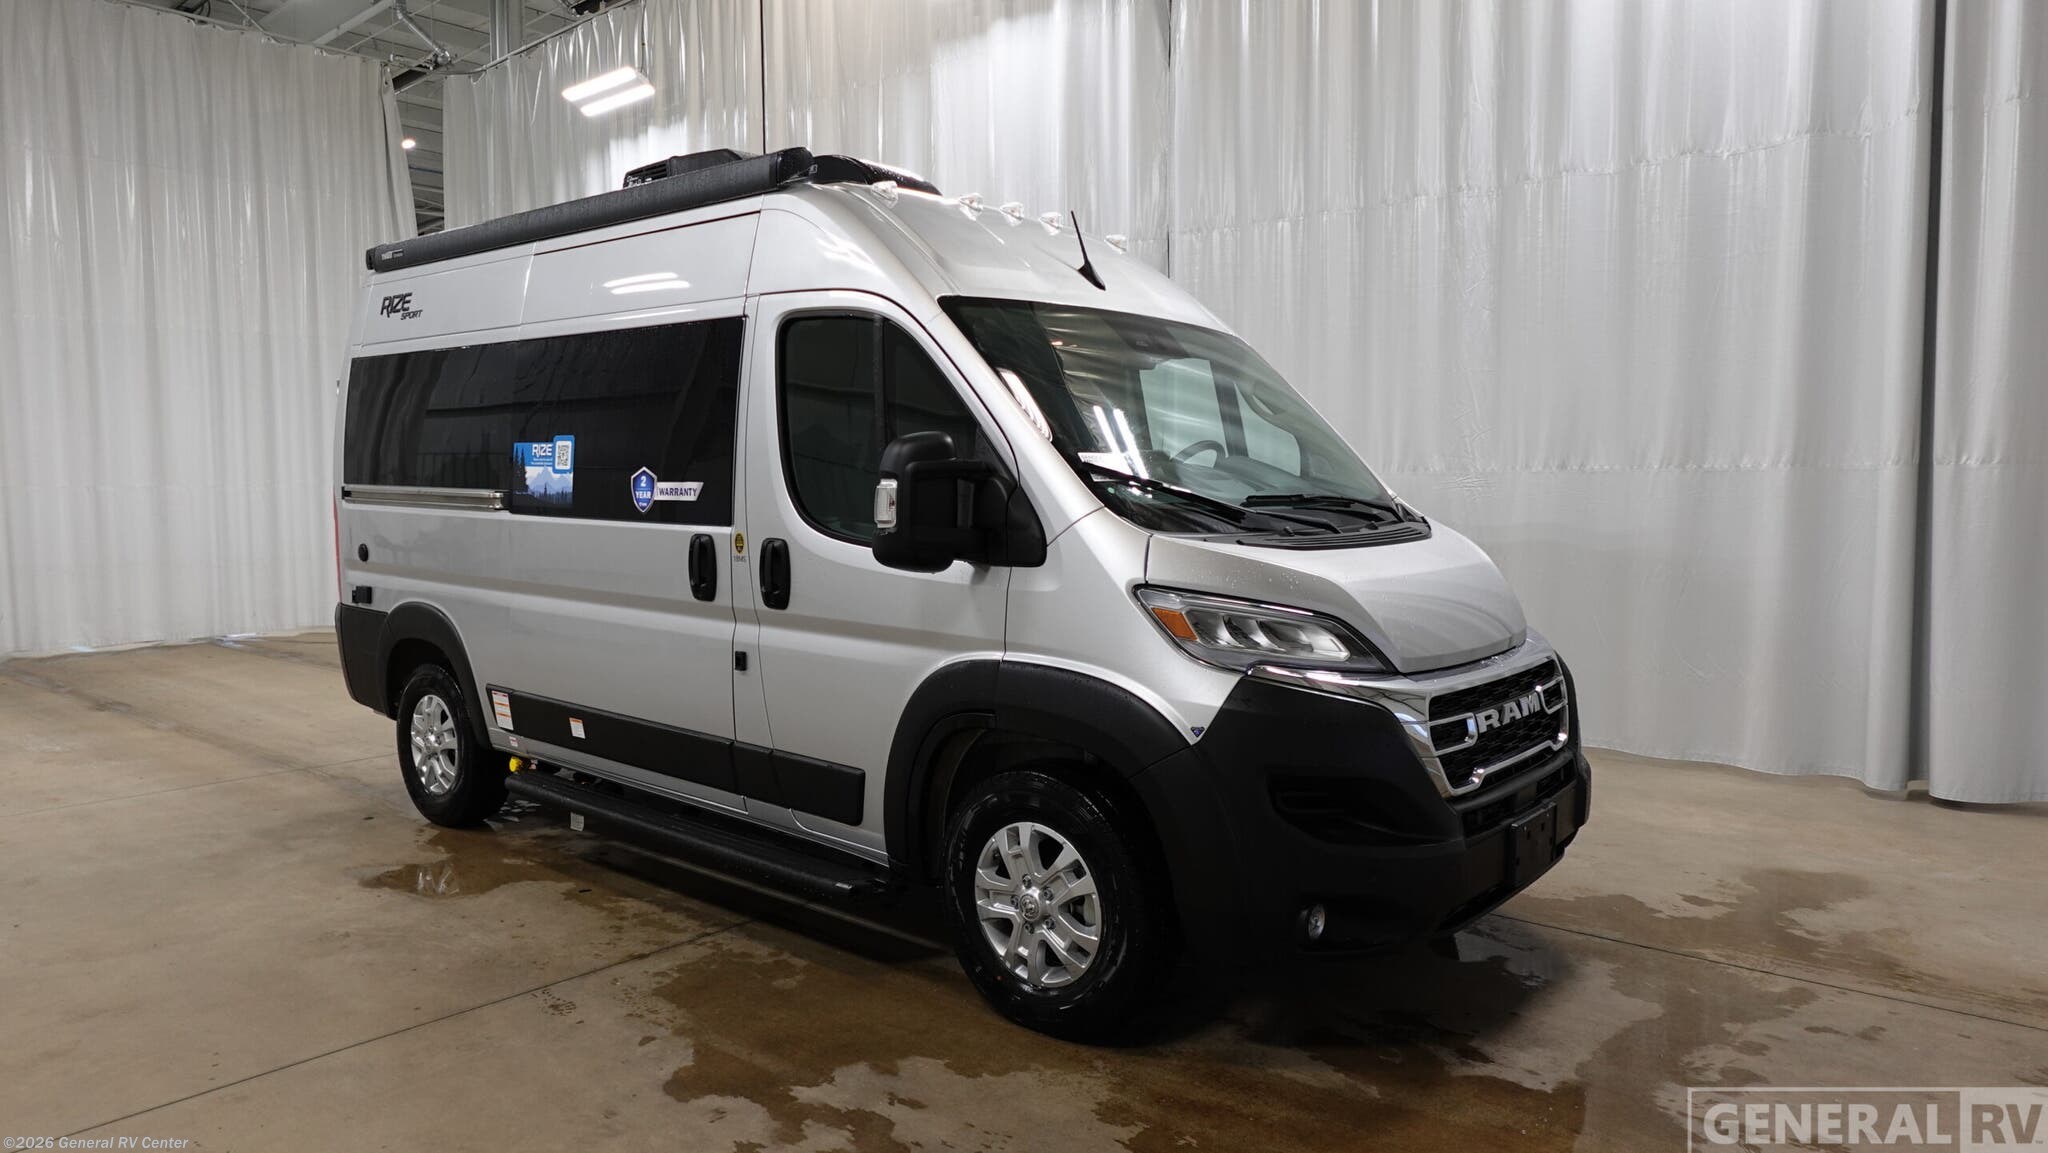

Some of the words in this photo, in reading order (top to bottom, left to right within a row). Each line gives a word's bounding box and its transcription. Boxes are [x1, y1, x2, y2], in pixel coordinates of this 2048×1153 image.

[380, 292, 413, 318] RIZE
[400, 309, 423, 320] SPORT
[532, 443, 553, 458] RIZE
[640, 475, 647, 487] 2
[635, 490, 652, 499] YEAR
[658, 487, 698, 497] WARRANTY
[1475, 691, 1541, 734] RAM
